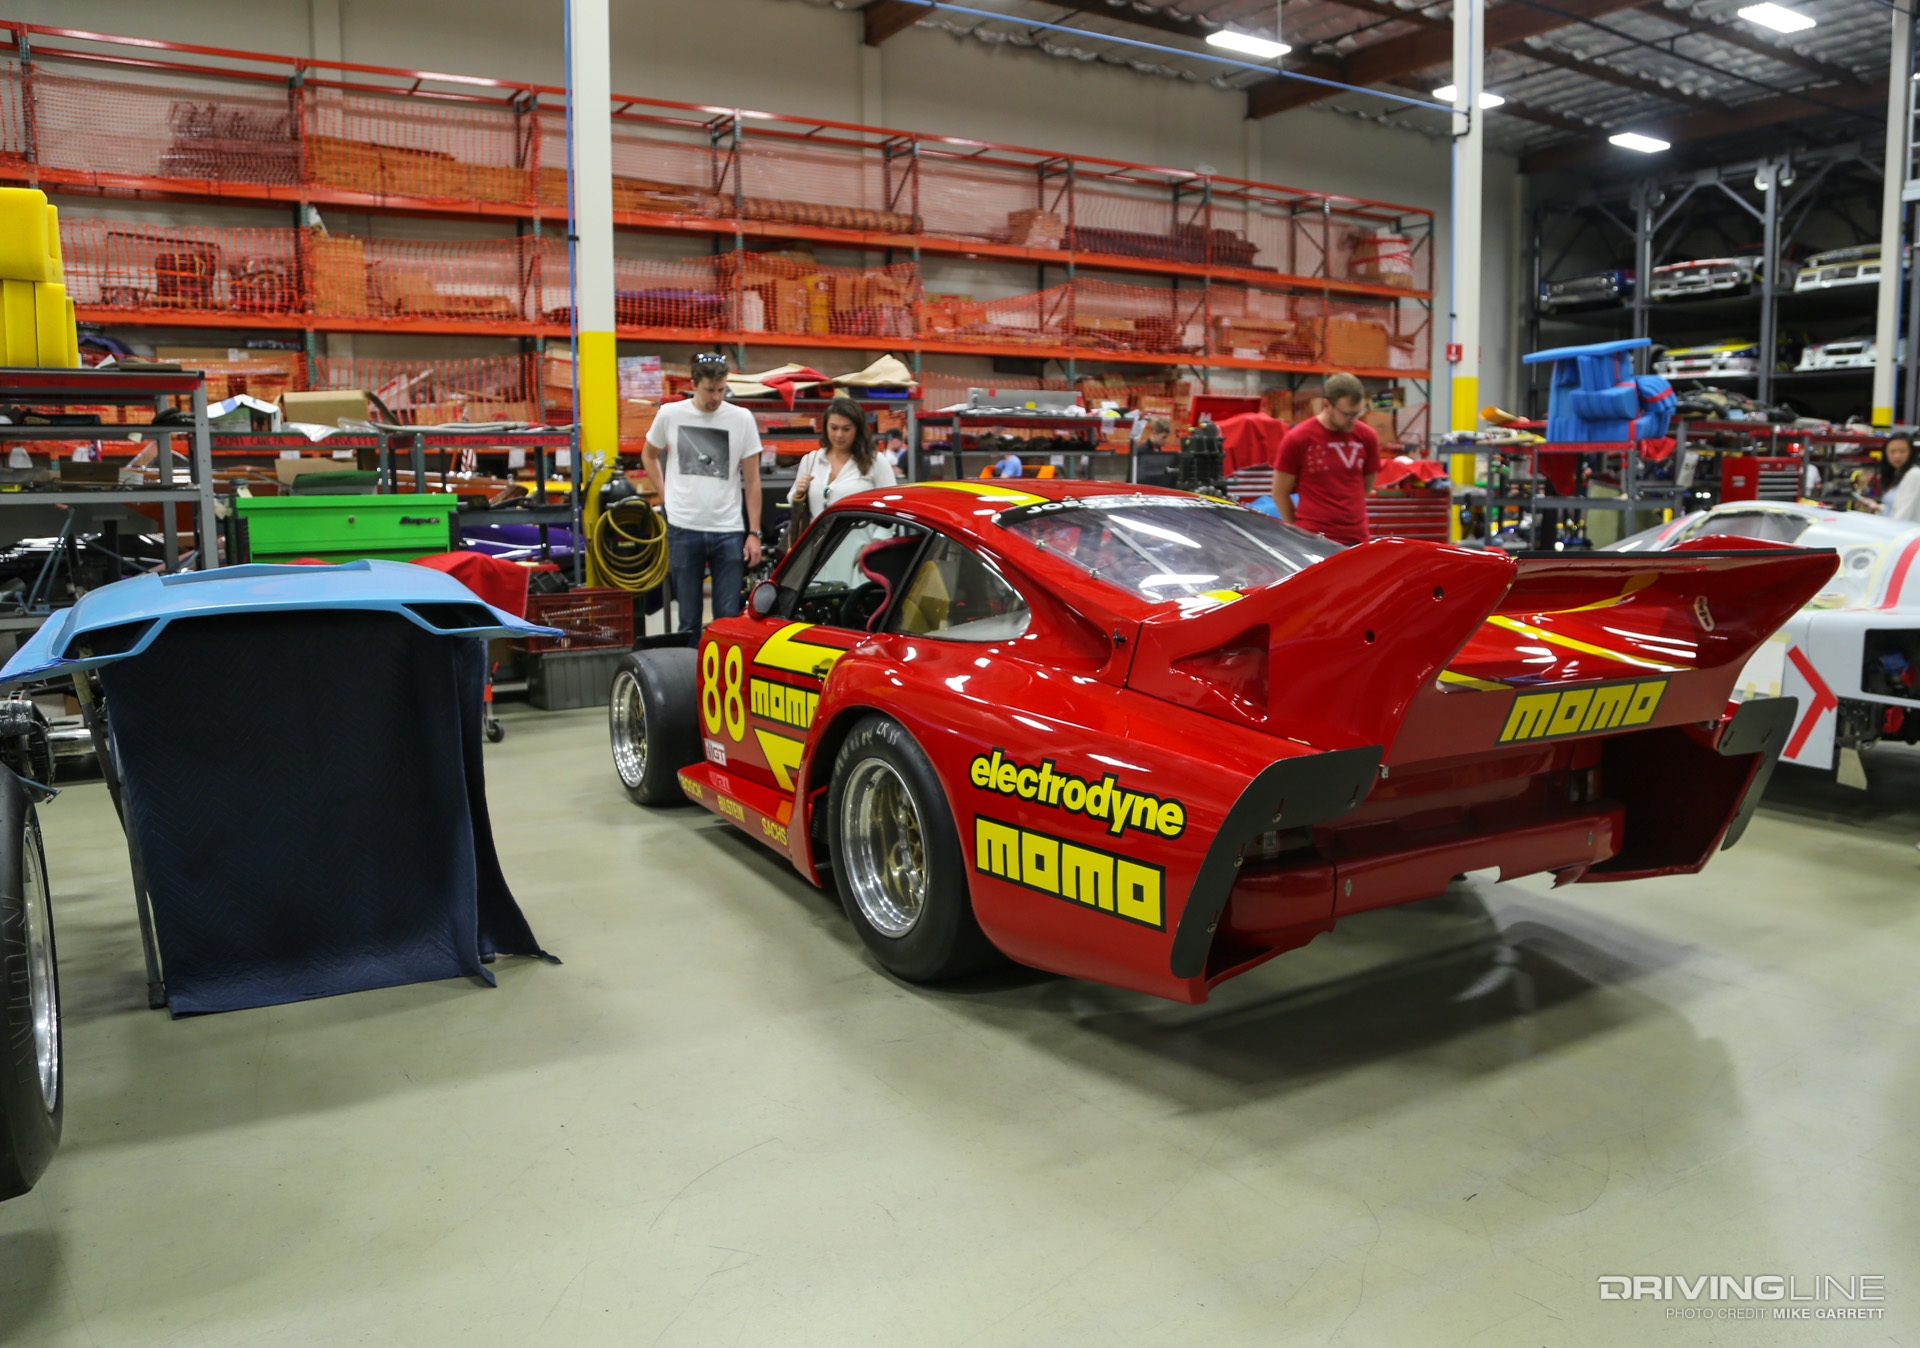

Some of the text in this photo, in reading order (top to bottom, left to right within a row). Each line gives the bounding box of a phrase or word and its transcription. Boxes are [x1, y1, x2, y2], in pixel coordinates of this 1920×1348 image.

[703, 641, 745, 742] 88
[713, 746, 726, 762] GT
[970, 749, 1185, 838] electrodyne
[762, 817, 788, 846] SACHS
